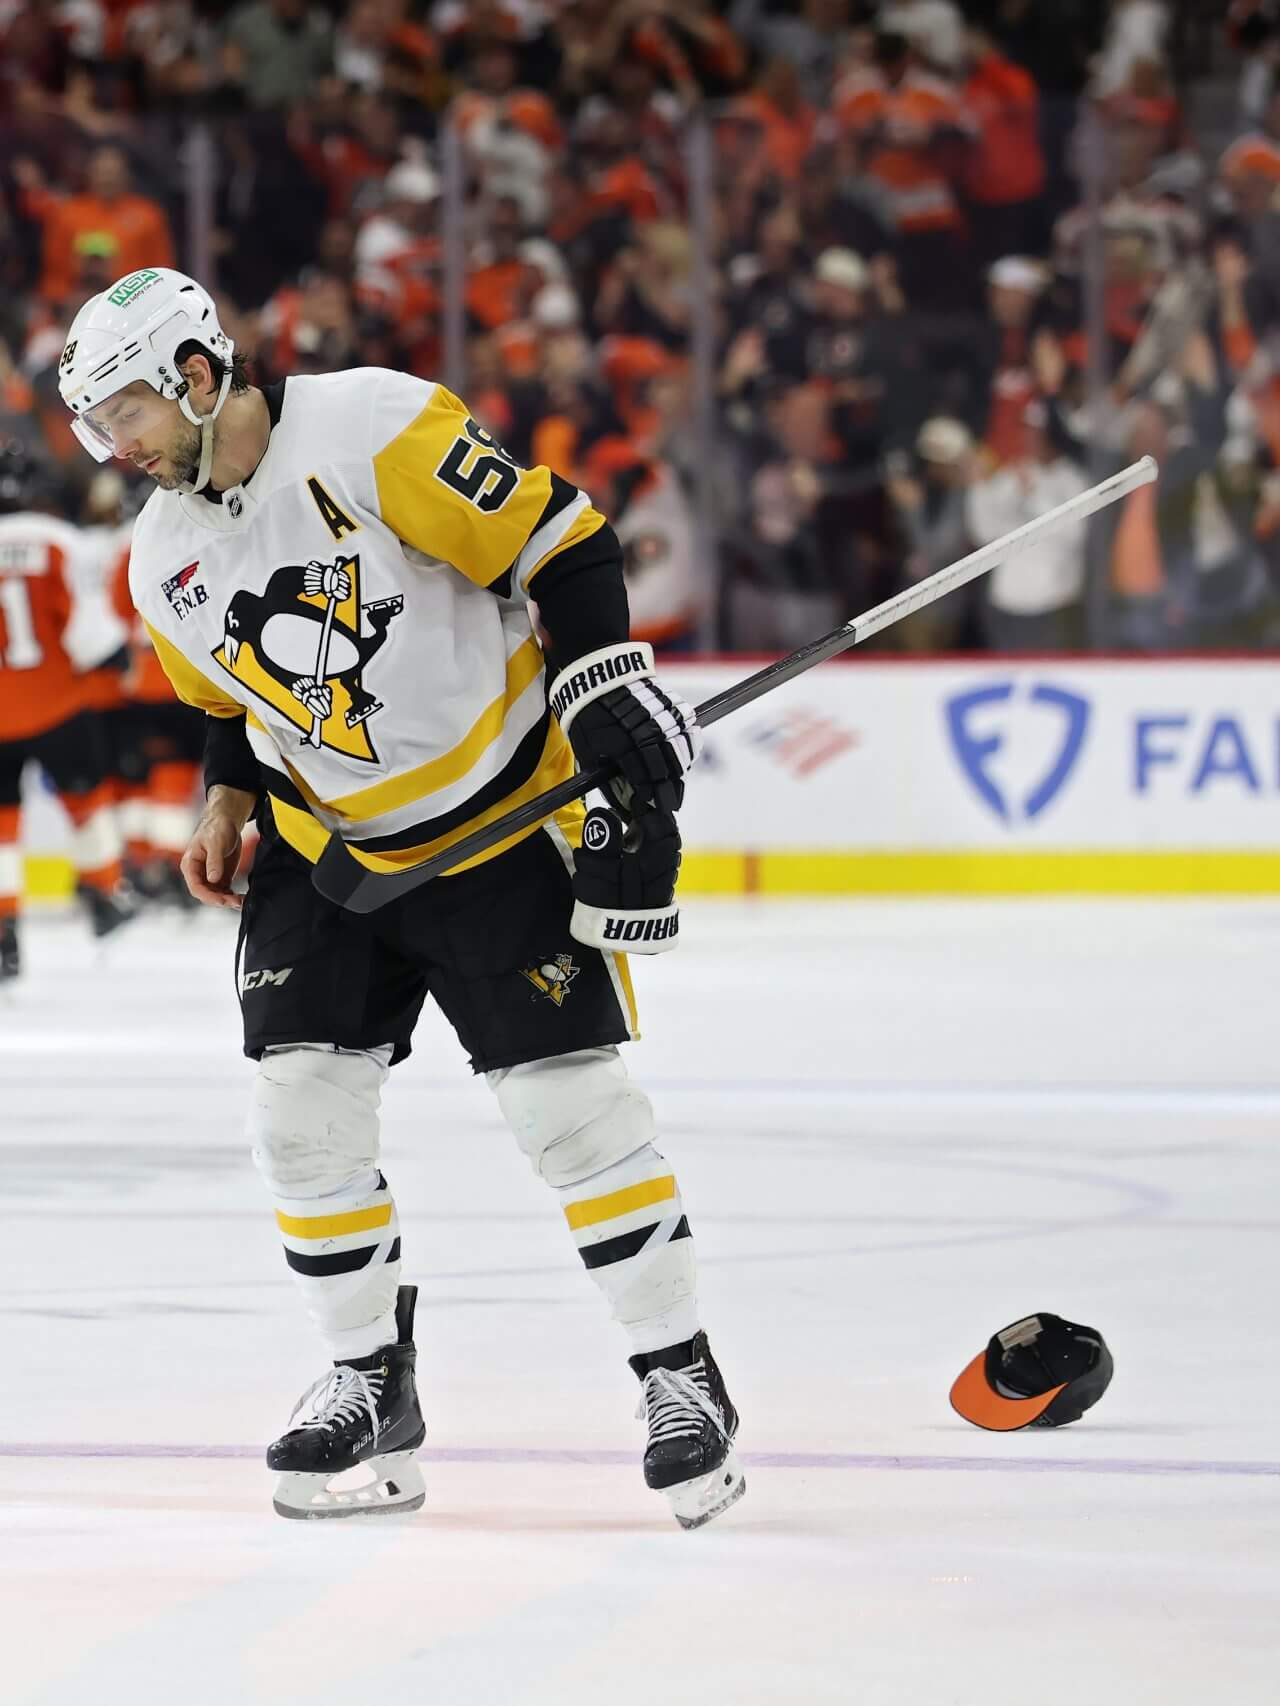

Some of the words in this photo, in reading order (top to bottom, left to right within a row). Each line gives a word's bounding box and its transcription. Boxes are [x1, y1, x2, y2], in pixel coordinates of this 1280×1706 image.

[109, 270, 159, 306] MSA
[305, 472, 361, 543] A
[172, 584, 210, 621] F.N.B.
